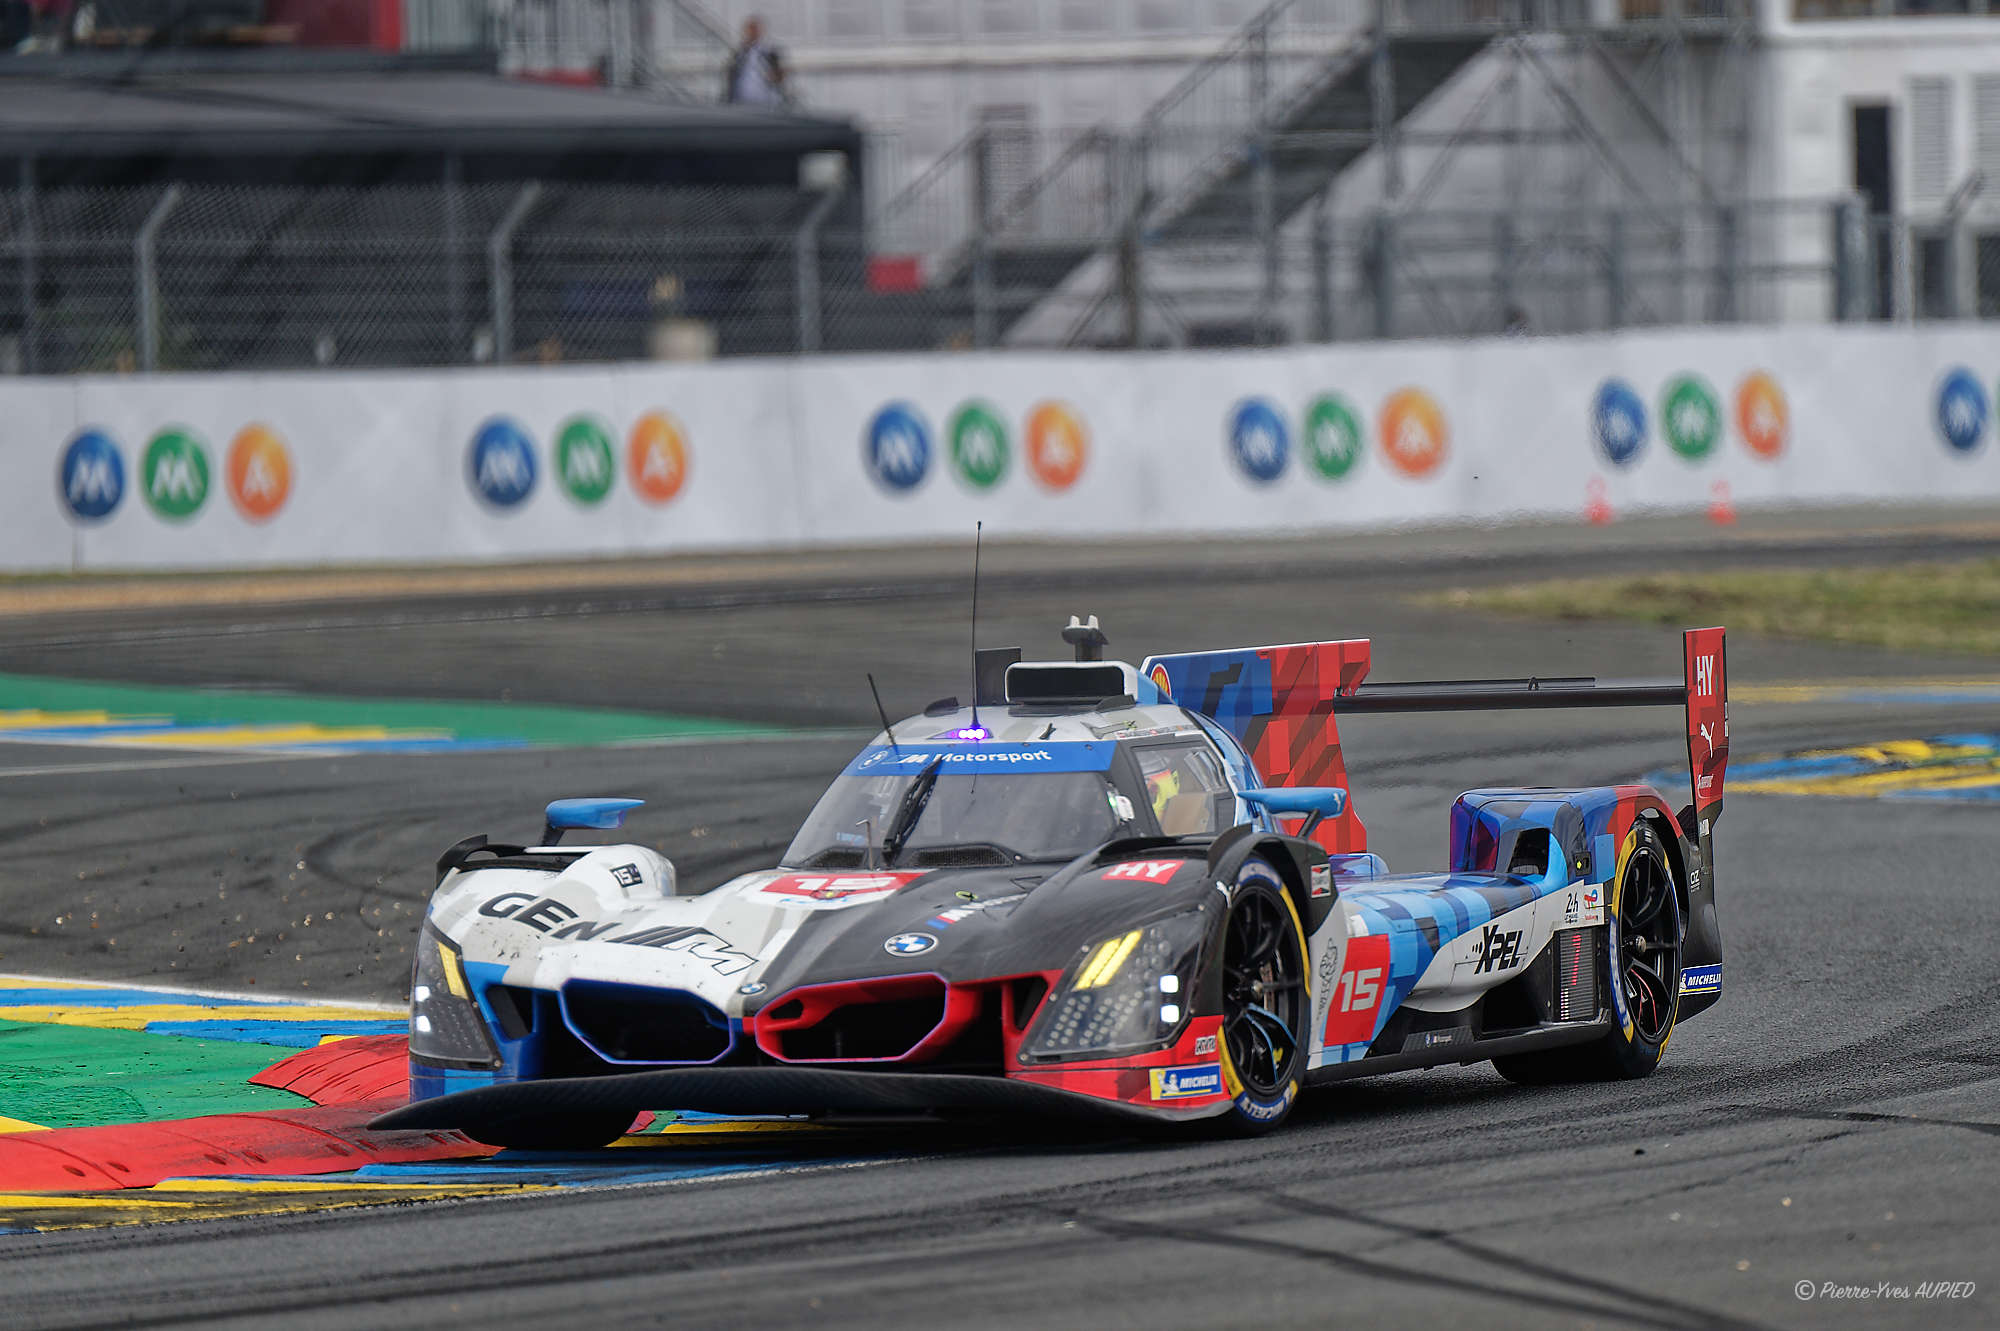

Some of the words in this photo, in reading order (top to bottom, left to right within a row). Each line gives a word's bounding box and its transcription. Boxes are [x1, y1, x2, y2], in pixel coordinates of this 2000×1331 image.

[1696, 654, 1715, 697] HY
[932, 749, 1052, 764] Motorsport
[793, 876, 897, 891] 15
[1107, 861, 1178, 879] HY
[477, 891, 623, 942] GEN
[1473, 924, 1523, 975] XPEL
[1340, 967, 1383, 1013] 15
